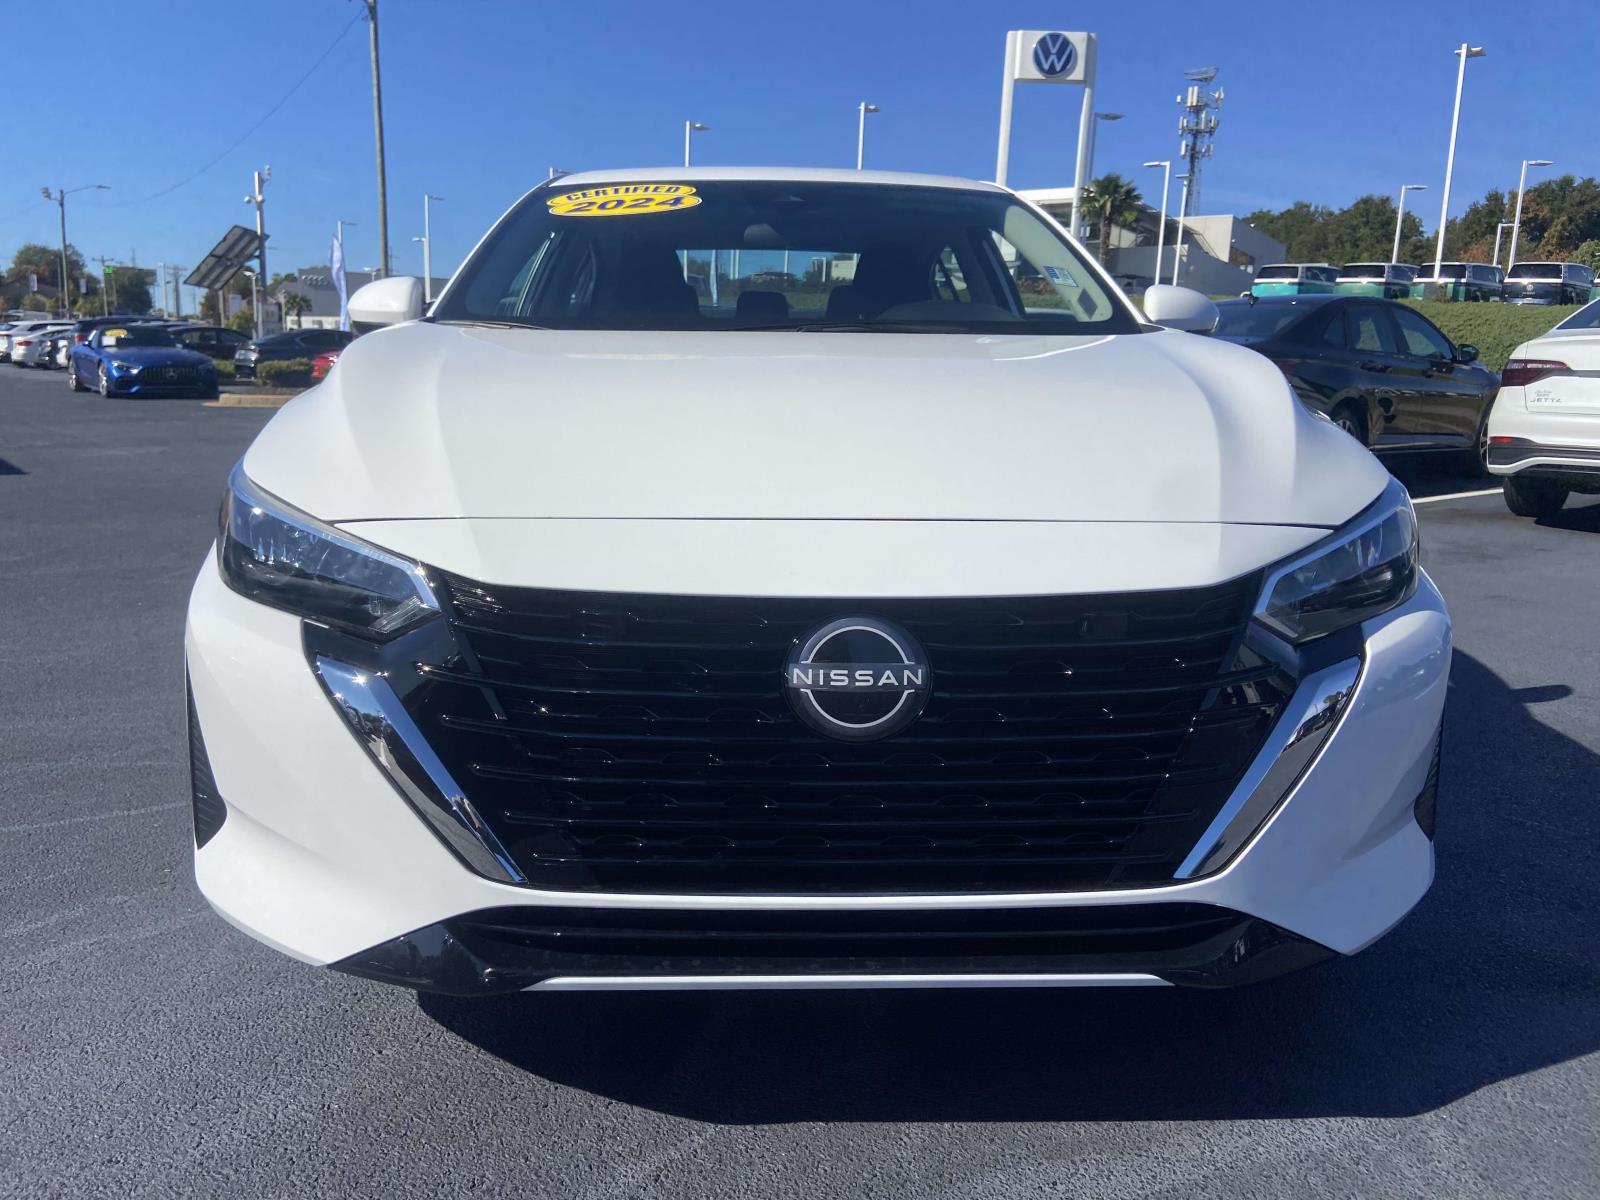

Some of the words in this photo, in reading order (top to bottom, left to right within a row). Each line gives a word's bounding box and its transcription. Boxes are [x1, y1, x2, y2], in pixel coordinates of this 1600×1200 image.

[1035, 34, 1073, 73] VW
[566, 185, 680, 201] CERTIFIED
[564, 196, 684, 213] 2024
[792, 667, 923, 687] NISSAN
